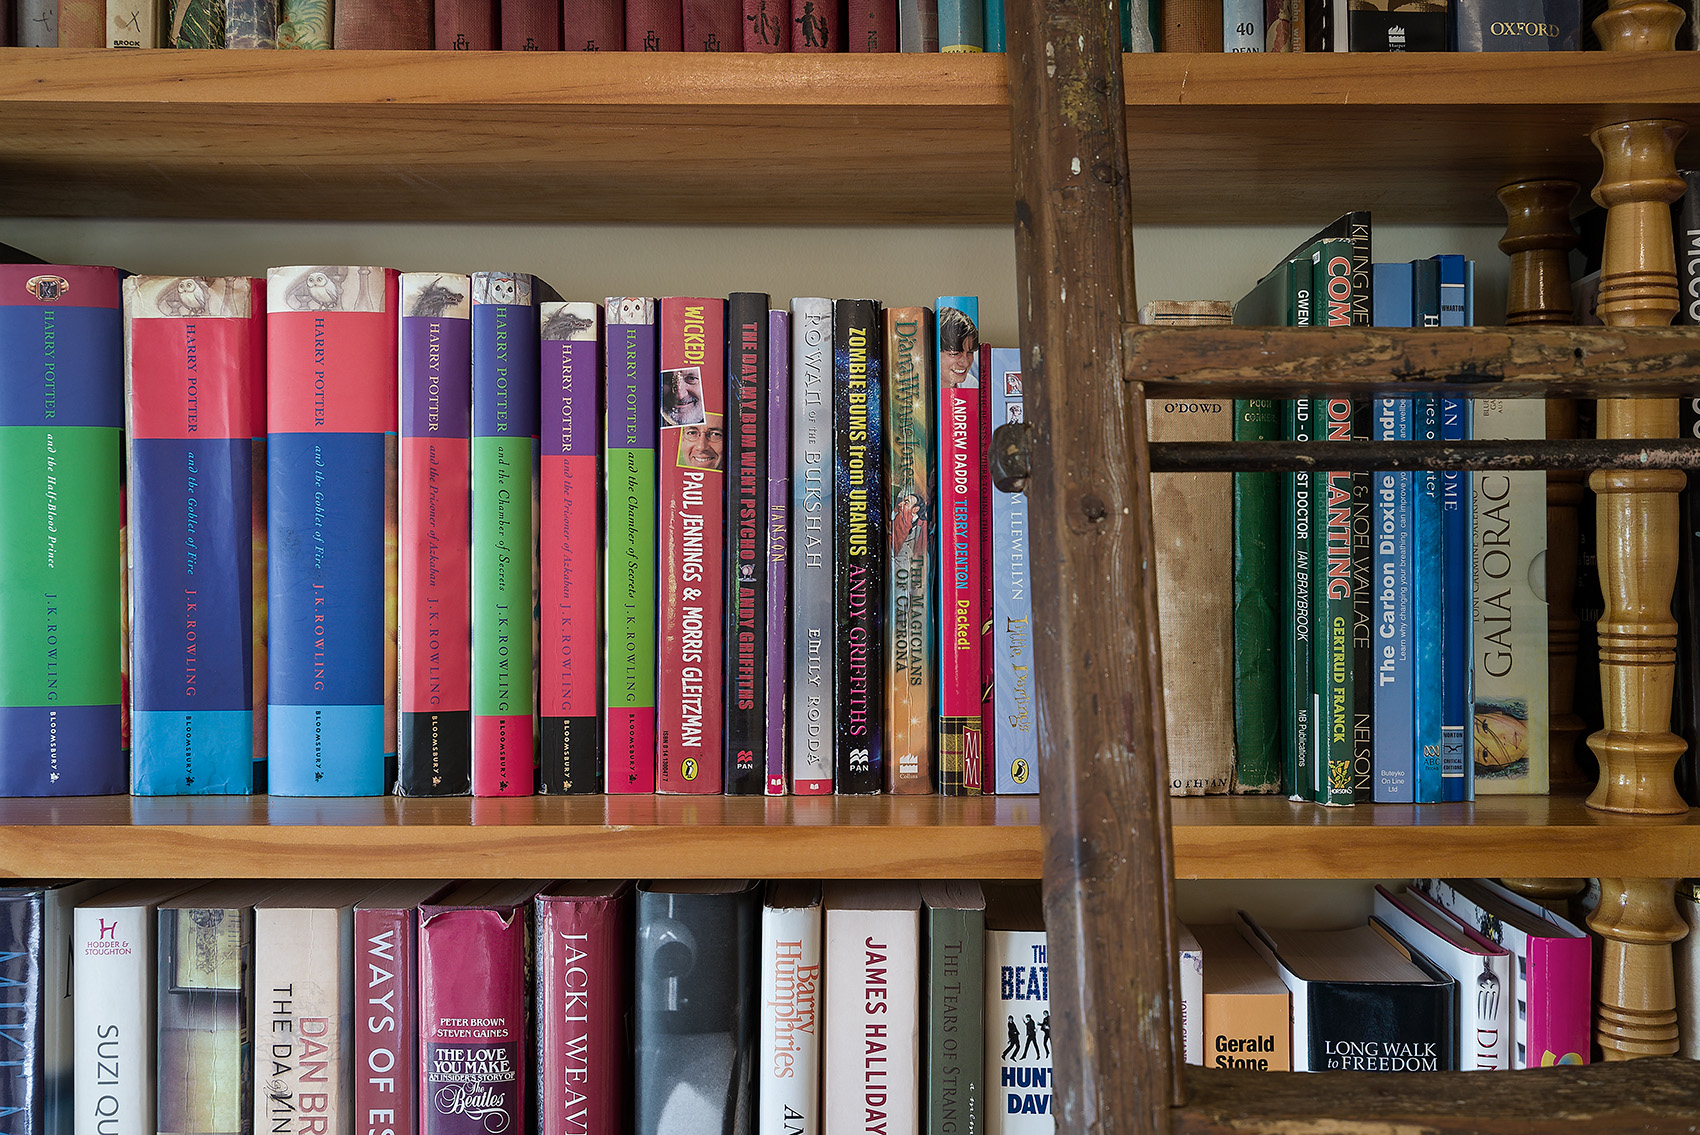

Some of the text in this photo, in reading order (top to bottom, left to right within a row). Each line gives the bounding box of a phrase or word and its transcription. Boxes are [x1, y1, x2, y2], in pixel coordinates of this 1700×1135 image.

[1236, 22, 1254, 36] 40
[1490, 22, 1560, 37] OXFORD
[44, 310, 56, 419] HARRY POTTER
[186, 325, 198, 432] HARRY POTTER
[314, 319, 324, 426] HARRY POTTER
[428, 323, 440, 431] HARRY POTTER
[496, 306, 508, 432] HARRY POTTER
[684, 305, 706, 366] WICKED!
[896, 320, 918, 372] Diana
[562, 344, 572, 452] HARRY POTTER
[626, 330, 638, 444] HARRY POTTER
[1165, 404, 1222, 413] O'DOWD
[1352, 224, 1370, 648] KILLING NOEL WALLACE
[804, 312, 822, 569] ROWAN BUKSHAH
[848, 328, 867, 556] ZOMBIE BUMS from URANUS
[954, 398, 968, 494] ANDREW DADDO
[46, 434, 56, 568] and the Half-Blood Prince
[184, 452, 198, 574] and the Goblet of Fire
[426, 446, 440, 586] and the Prisoner of Azkaban
[494, 447, 510, 591] and the Chamber of Secrets
[738, 322, 758, 710] THE DAY MY BUM WENT PSYCHO ANDY GRIFFITHS
[771, 505, 786, 563] HANSON
[955, 500, 969, 590] TERRY DENTON
[1297, 491, 1310, 539] DOCTOR
[1010, 513, 1024, 599] LLEWELLYN
[1297, 550, 1308, 642] IAN BRAYBROOK
[1380, 476, 1395, 686] The Carbon Dioxide
[1398, 486, 1410, 660] Learn why changing your breathing can improve
[46, 592, 58, 700] J.K.ROWLING
[186, 589, 196, 696] J.K.ROWLING
[314, 584, 324, 690] J.K.ROWLING
[428, 598, 440, 705] J.K.ROWLING
[496, 603, 508, 711] J.K.ROWLING
[562, 604, 572, 710] J.K.ROWLING
[626, 602, 636, 702] J.K.ROWLING
[680, 472, 704, 746] PAUL JENNINGS & MORRIS GLEITZMAN
[850, 564, 867, 736] ANDY GRIFFITHS
[896, 569, 911, 674] OF CAPRONA
[910, 556, 924, 686] THE MAGICIANS
[956, 599, 970, 650] Dacked!
[1483, 588, 1512, 678] GAIA
[807, 628, 822, 766] EMILY RODDA
[1333, 617, 1346, 743] GERTRUD FRANCK
[50, 712, 58, 769] BLOOMSBURY
[1298, 710, 1306, 767] MB Publications
[1354, 714, 1370, 790] NELSON
[1381, 770, 1405, 778] Buteyko
[560, 932, 588, 1023] JACKI
[795, 964, 819, 1036] Barry
[942, 940, 962, 976] THE
[942, 982, 962, 1032] TEARS
[98, 1025, 119, 1085] SUZI
[272, 984, 292, 1076] THE DA
[298, 1017, 328, 1082] DAN
[368, 930, 394, 1093] WAYS OF
[436, 1048, 507, 1062] THE LOVE
[437, 1028, 508, 1038] STEVEN GAINES
[440, 1017, 505, 1027] PETER BROWN
[766, 940, 802, 1078] Humphries
[865, 936, 887, 1135] JAMES HALLIDAY
[942, 1039, 962, 1060] OF
[1216, 1036, 1274, 1052] Gerald
[1326, 1040, 1437, 1056] LONG WALK
[434, 1061, 510, 1073] YOU MAKE
[1216, 1056, 1268, 1069] Stone
[1328, 1058, 1438, 1072] to FREEDOM
